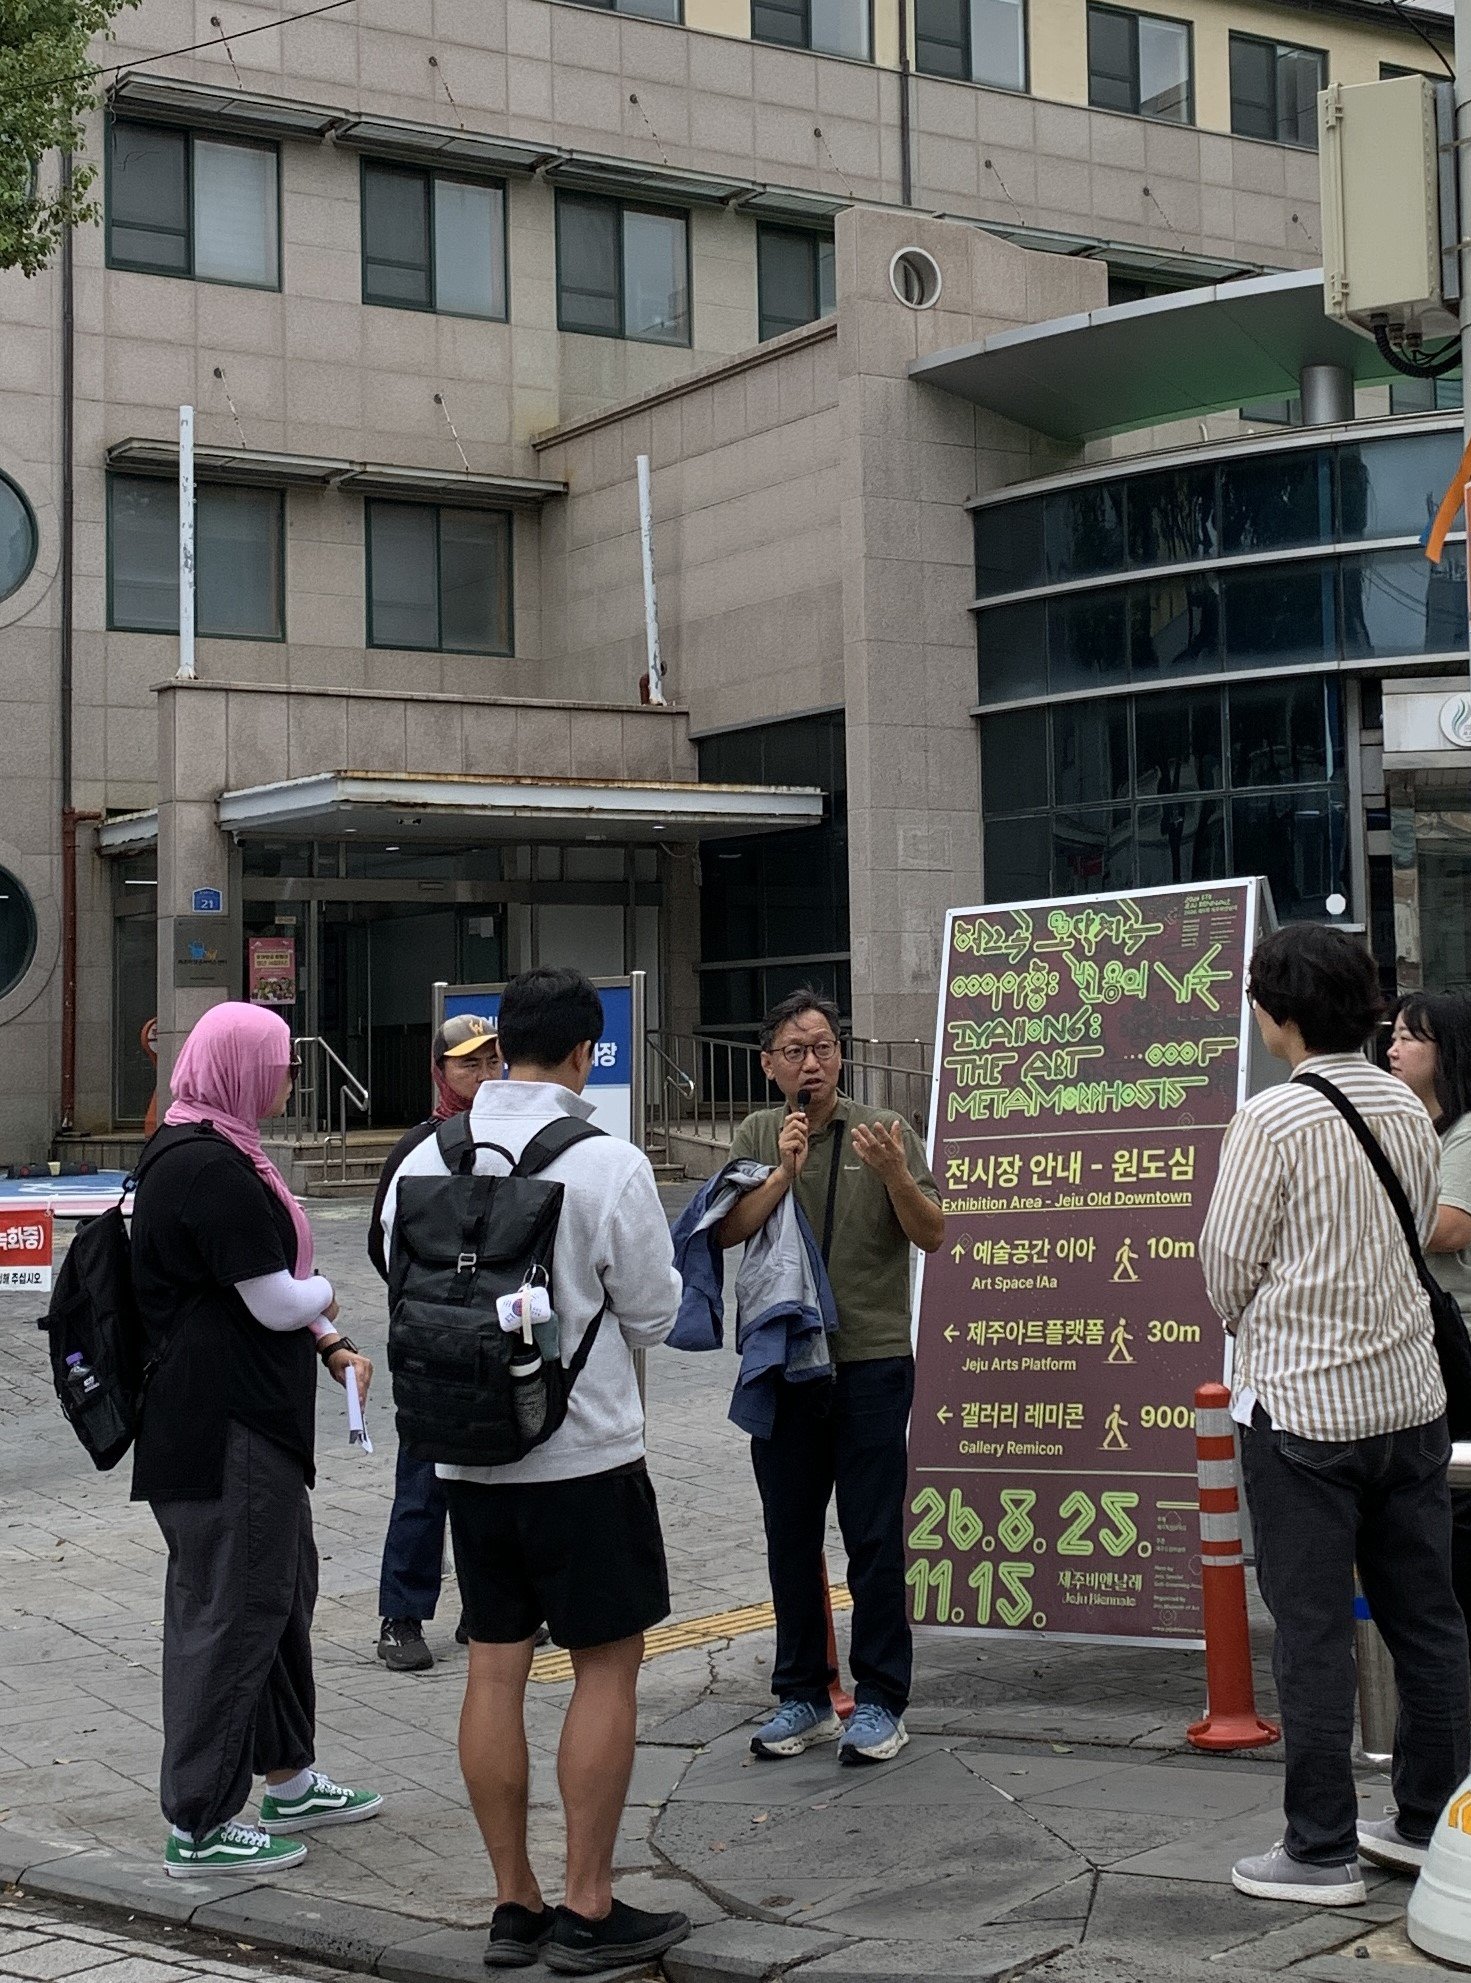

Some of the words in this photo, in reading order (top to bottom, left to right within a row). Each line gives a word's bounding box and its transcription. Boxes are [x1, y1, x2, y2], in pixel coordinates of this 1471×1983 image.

[201, 899, 214, 909] 21
[944, 1052, 1018, 1087] THE
[1021, 1045, 1105, 1081] ART
[946, 1075, 1210, 1122] METAMORPHOSIS
[945, 1154, 1023, 1190] 전시장
[1029, 1150, 1083, 1186] 안내
[1111, 1145, 1196, 1183] 원도심
[942, 1197, 1007, 1212] Exhibition
[1010, 1196, 1042, 1209] Area
[1055, 1194, 1084, 1208] Jeju
[1087, 1192, 1111, 1206] Old
[1115, 1190, 1192, 1206] Downtown
[973, 1237, 1050, 1265] 예술공간
[1056, 1236, 1096, 1264] 이아
[1147, 1236, 1195, 1259] 10m
[972, 1277, 992, 1290] Art
[994, 1276, 1034, 1292] Space
[967, 1319, 1105, 1346] 제주아트플랫폼
[1147, 1320, 1201, 1343] 30m
[961, 1357, 989, 1373] Jeju
[991, 1357, 1019, 1371] Arts
[1021, 1356, 1077, 1371] Platform
[960, 1403, 1019, 1429] 갤러리
[1024, 1403, 1085, 1430] 레미콘
[1140, 1405, 1196, 1428] 900
[959, 1440, 1005, 1457] Gallery
[1007, 1441, 1063, 1456] Remicon
